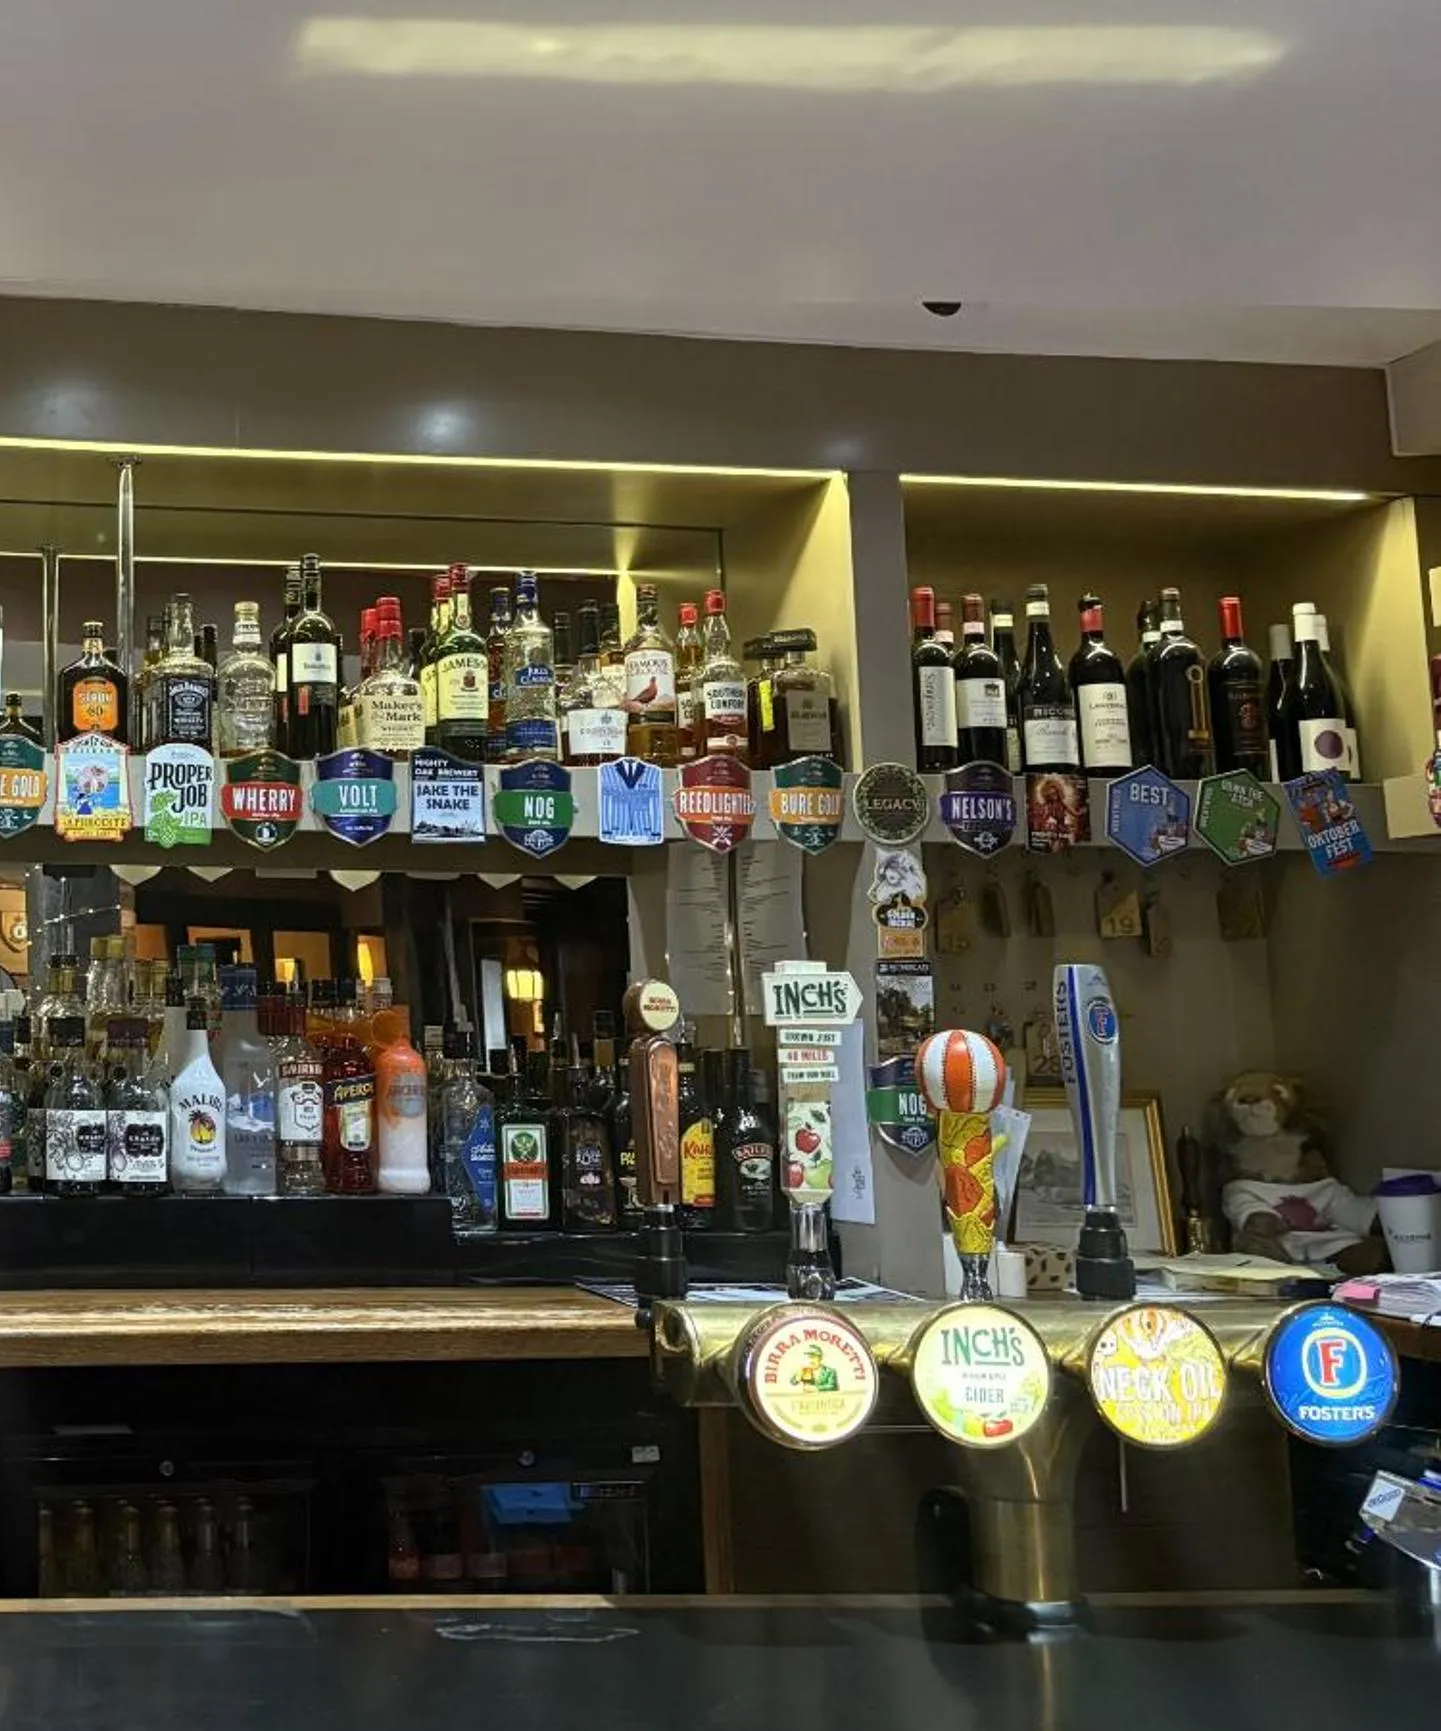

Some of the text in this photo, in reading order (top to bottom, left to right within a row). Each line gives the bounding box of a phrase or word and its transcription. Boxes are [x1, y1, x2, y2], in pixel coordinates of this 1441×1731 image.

[385, 710, 422, 722] Mark
[11, 775, 41, 798] GOLD
[148, 762, 213, 790] PROPER
[171, 784, 208, 813] JOB
[232, 785, 296, 812] WHERRY
[338, 785, 378, 807] VOLT
[416, 784, 479, 797] JAKE THE
[1130, 782, 1170, 806] BEST
[426, 799, 470, 811] SNAKE
[524, 796, 555, 819] NOG
[781, 792, 813, 816] BURE
[951, 796, 1013, 821] NELSON'S
[183, 812, 208, 825] IPA
[772, 980, 848, 1017] INCH'S
[898, 1093, 928, 1117] NOG
[764, 1328, 868, 1385] BIRRA MORETTI
[941, 1326, 1026, 1368] INCH'S
[1317, 1340, 1344, 1386] F
[965, 1385, 1005, 1404] CIDER
[1098, 1363, 1220, 1403] NECK OIL
